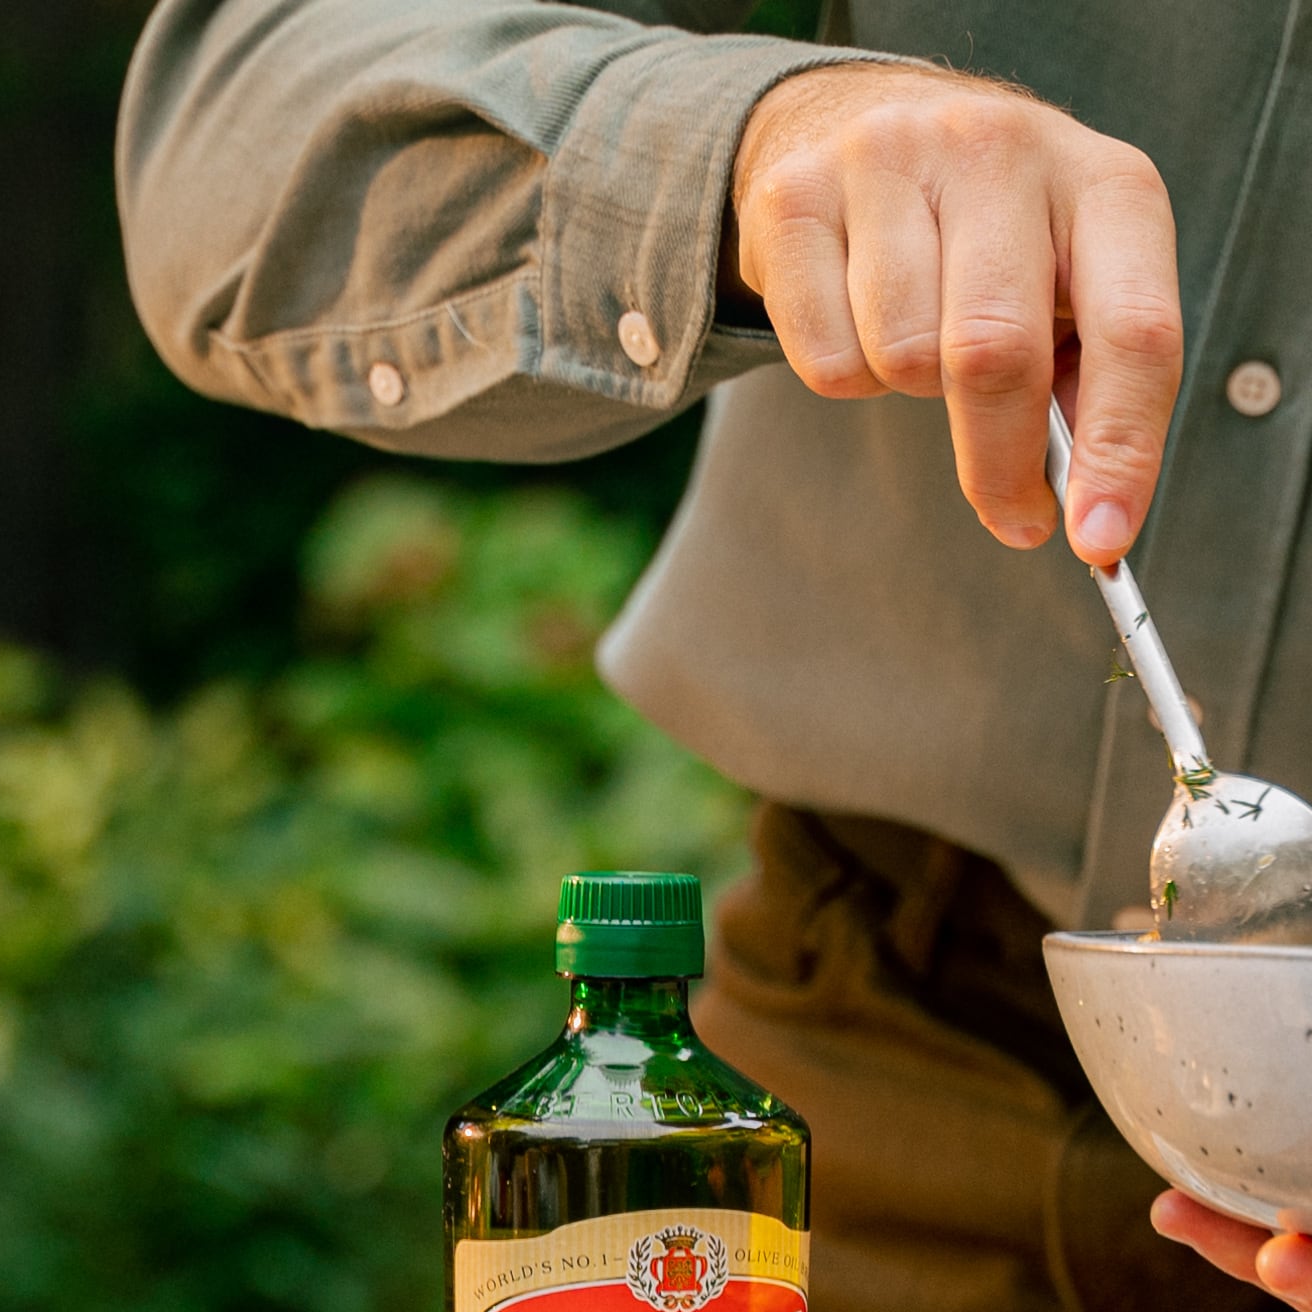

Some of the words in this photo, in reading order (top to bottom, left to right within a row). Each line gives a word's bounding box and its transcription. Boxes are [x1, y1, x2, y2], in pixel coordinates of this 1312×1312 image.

[473, 1261, 552, 1301] WORLD'S
[734, 1248, 780, 1266] OLIVE
[783, 1253, 799, 1272] OIL
